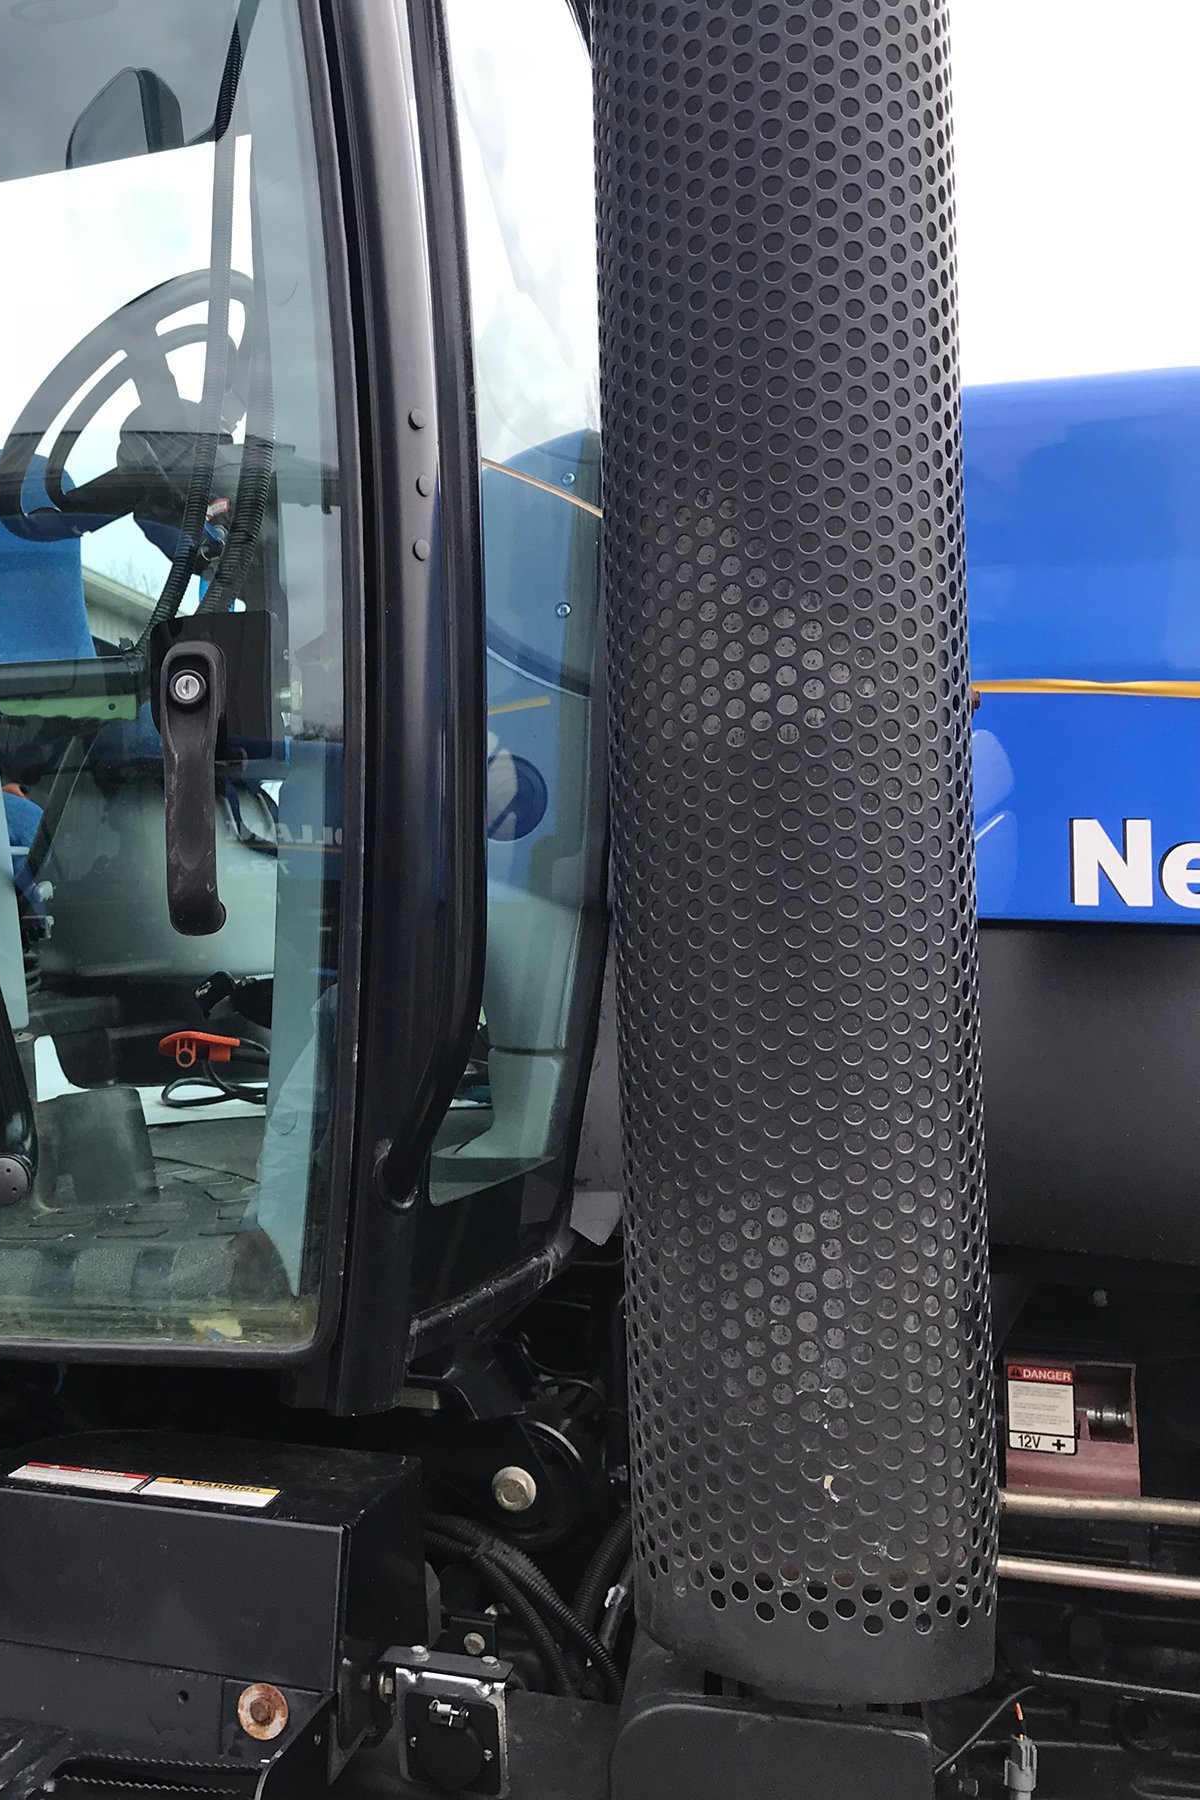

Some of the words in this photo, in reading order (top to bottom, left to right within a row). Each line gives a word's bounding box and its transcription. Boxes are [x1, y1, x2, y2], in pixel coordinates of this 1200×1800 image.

[1070, 817, 1200, 909] Ne
[1022, 1369, 1071, 1381] DANGER
[1019, 1435, 1041, 1448] 12V
[81, 1468, 125, 1476] DANGER
[192, 1481, 261, 1492] WARNING
